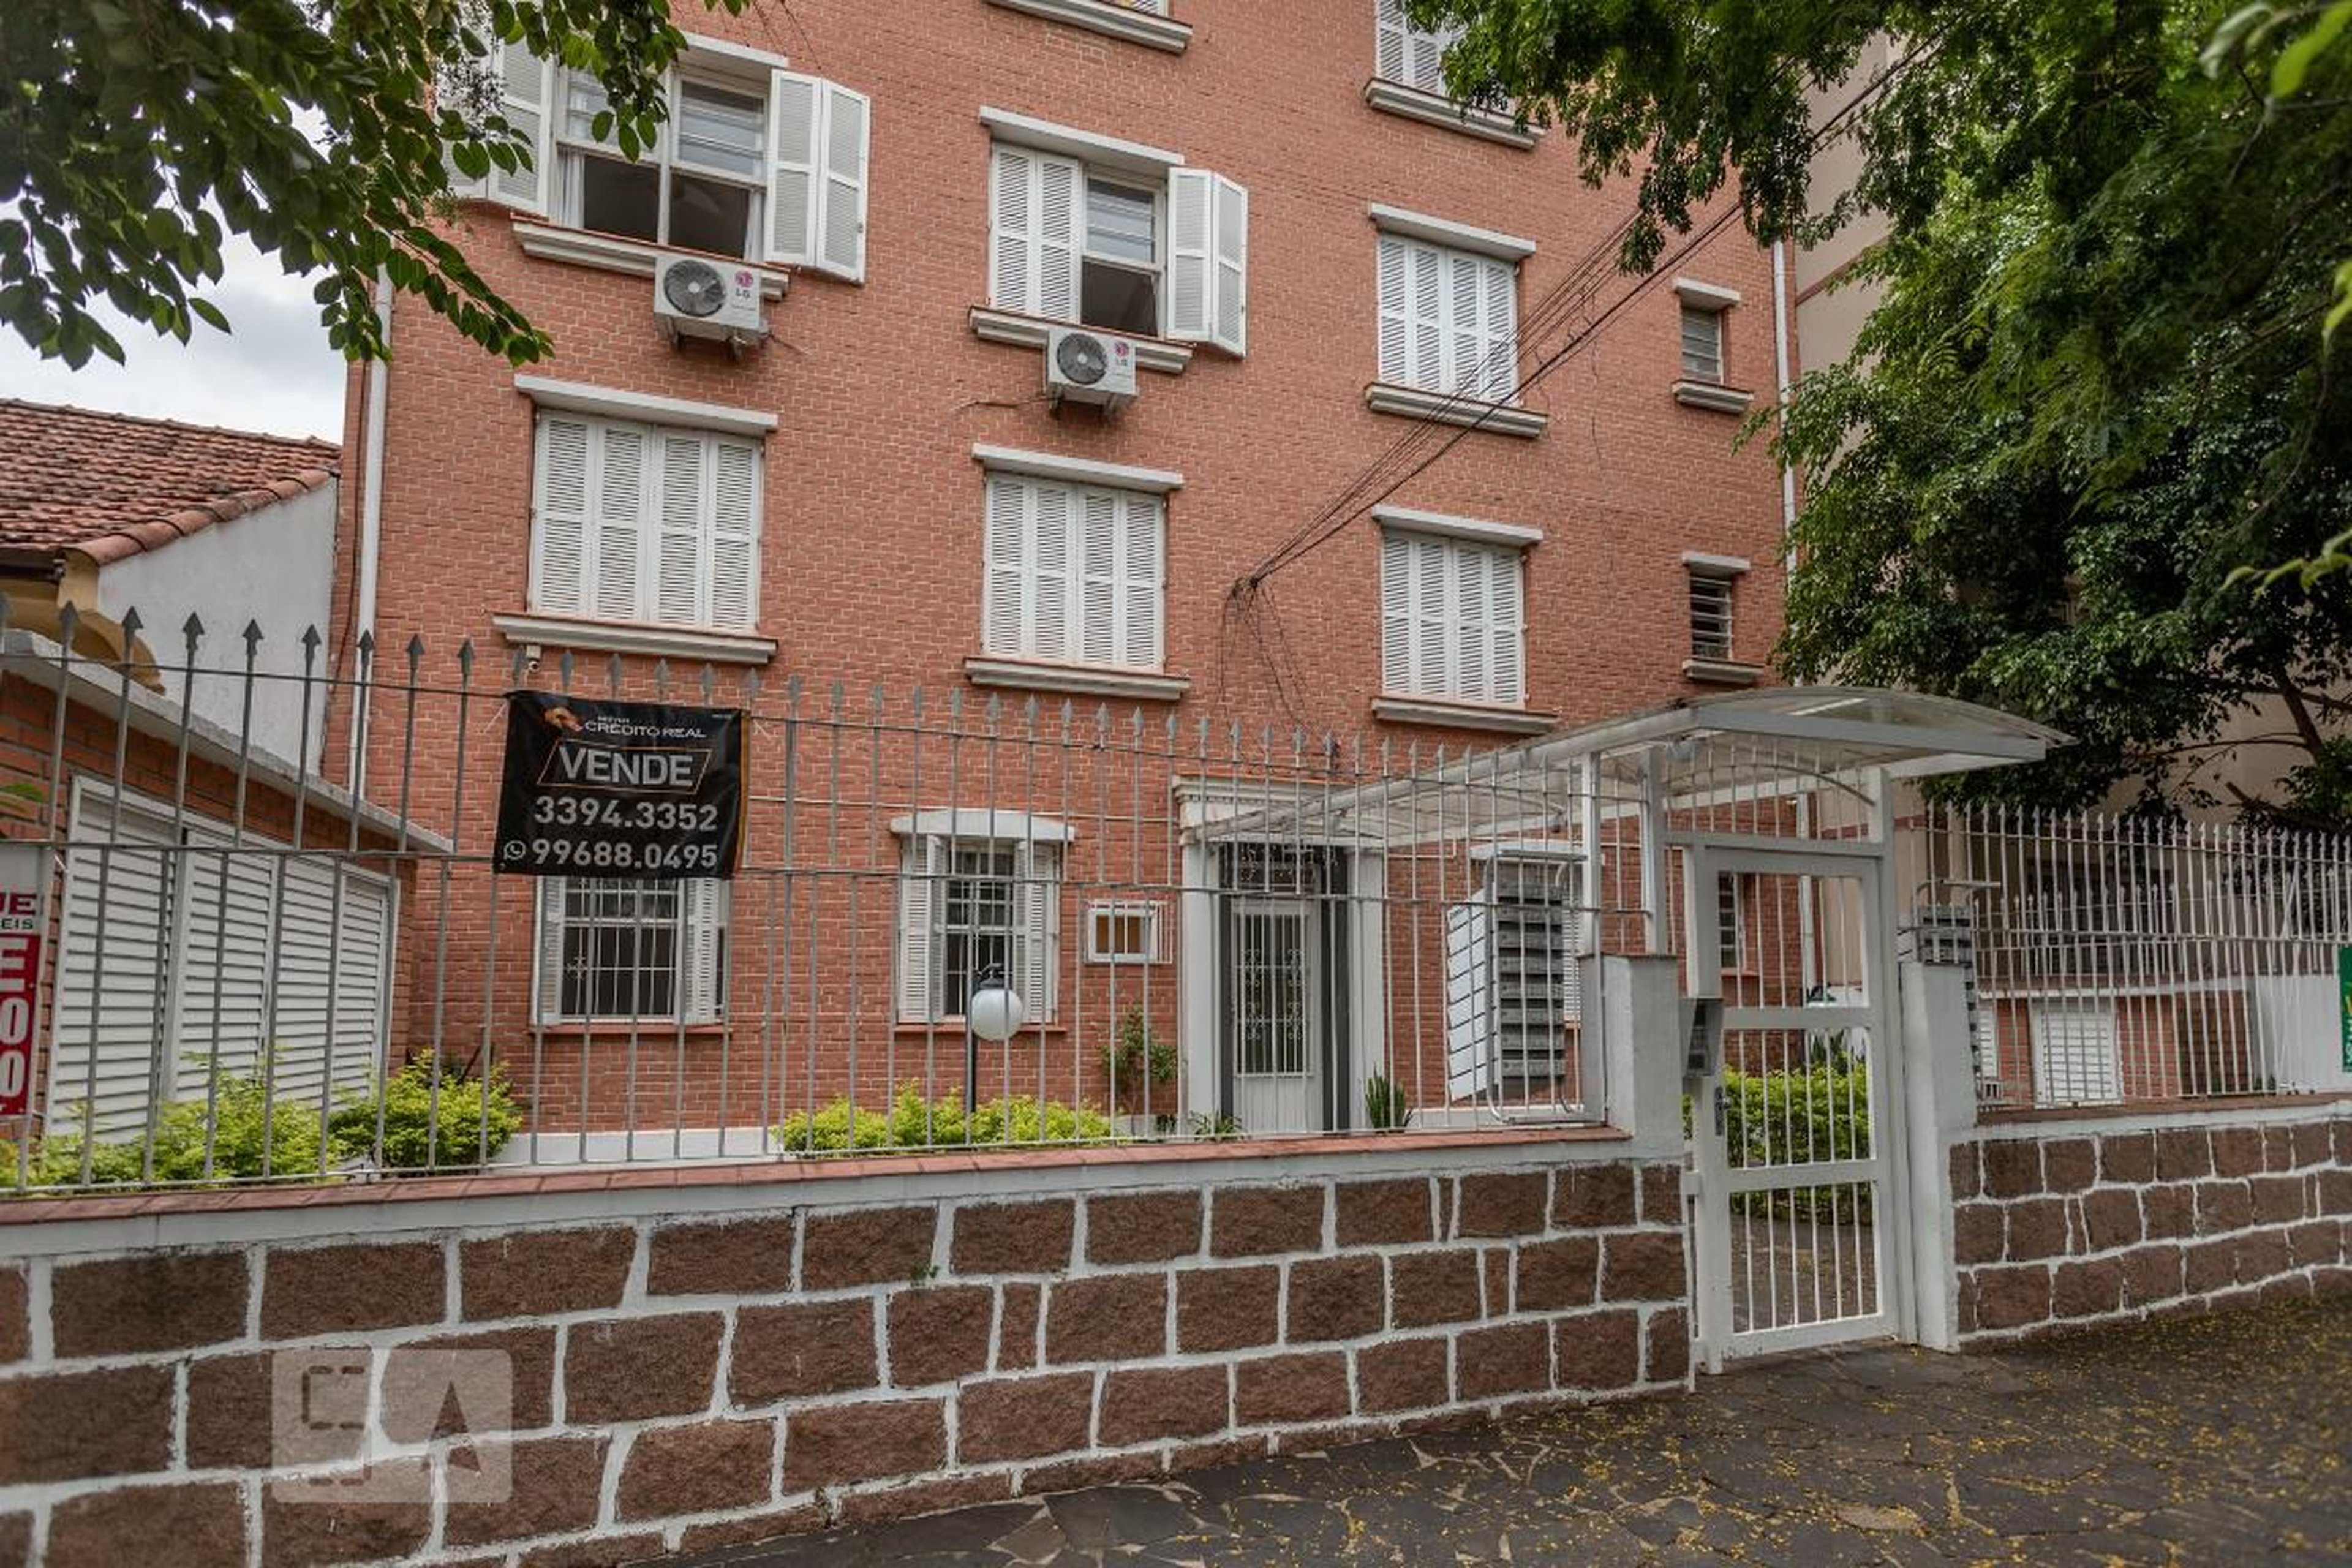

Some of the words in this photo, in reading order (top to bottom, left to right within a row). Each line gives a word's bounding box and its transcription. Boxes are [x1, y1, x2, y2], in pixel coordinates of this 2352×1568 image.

[662, 728, 707, 738] REAL
[559, 746, 693, 786] VENDE
[534, 796, 718, 831] 3394.3352
[532, 839, 718, 870] 99688.0495
